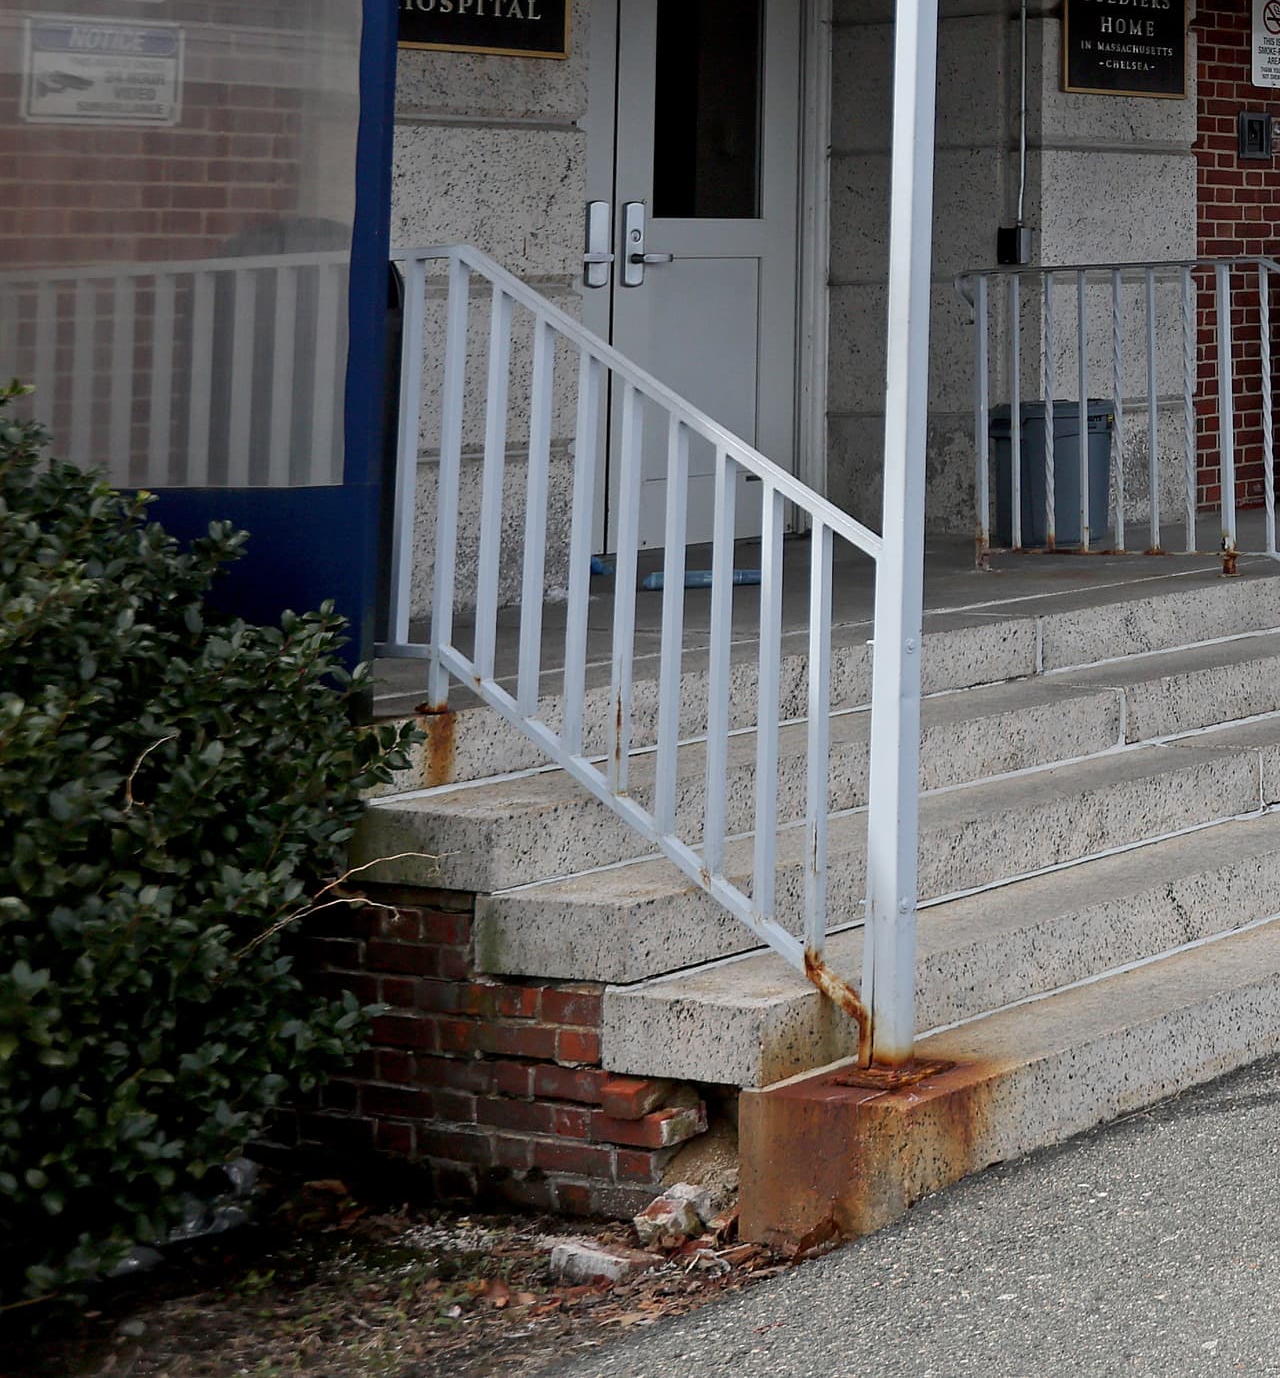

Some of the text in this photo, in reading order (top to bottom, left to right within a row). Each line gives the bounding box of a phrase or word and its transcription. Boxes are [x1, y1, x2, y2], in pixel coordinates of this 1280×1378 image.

[1100, 16, 1155, 37] HOME
[69, 27, 144, 51] NOTICE
[1080, 40, 1174, 57] IN MASSACHUSETTS
